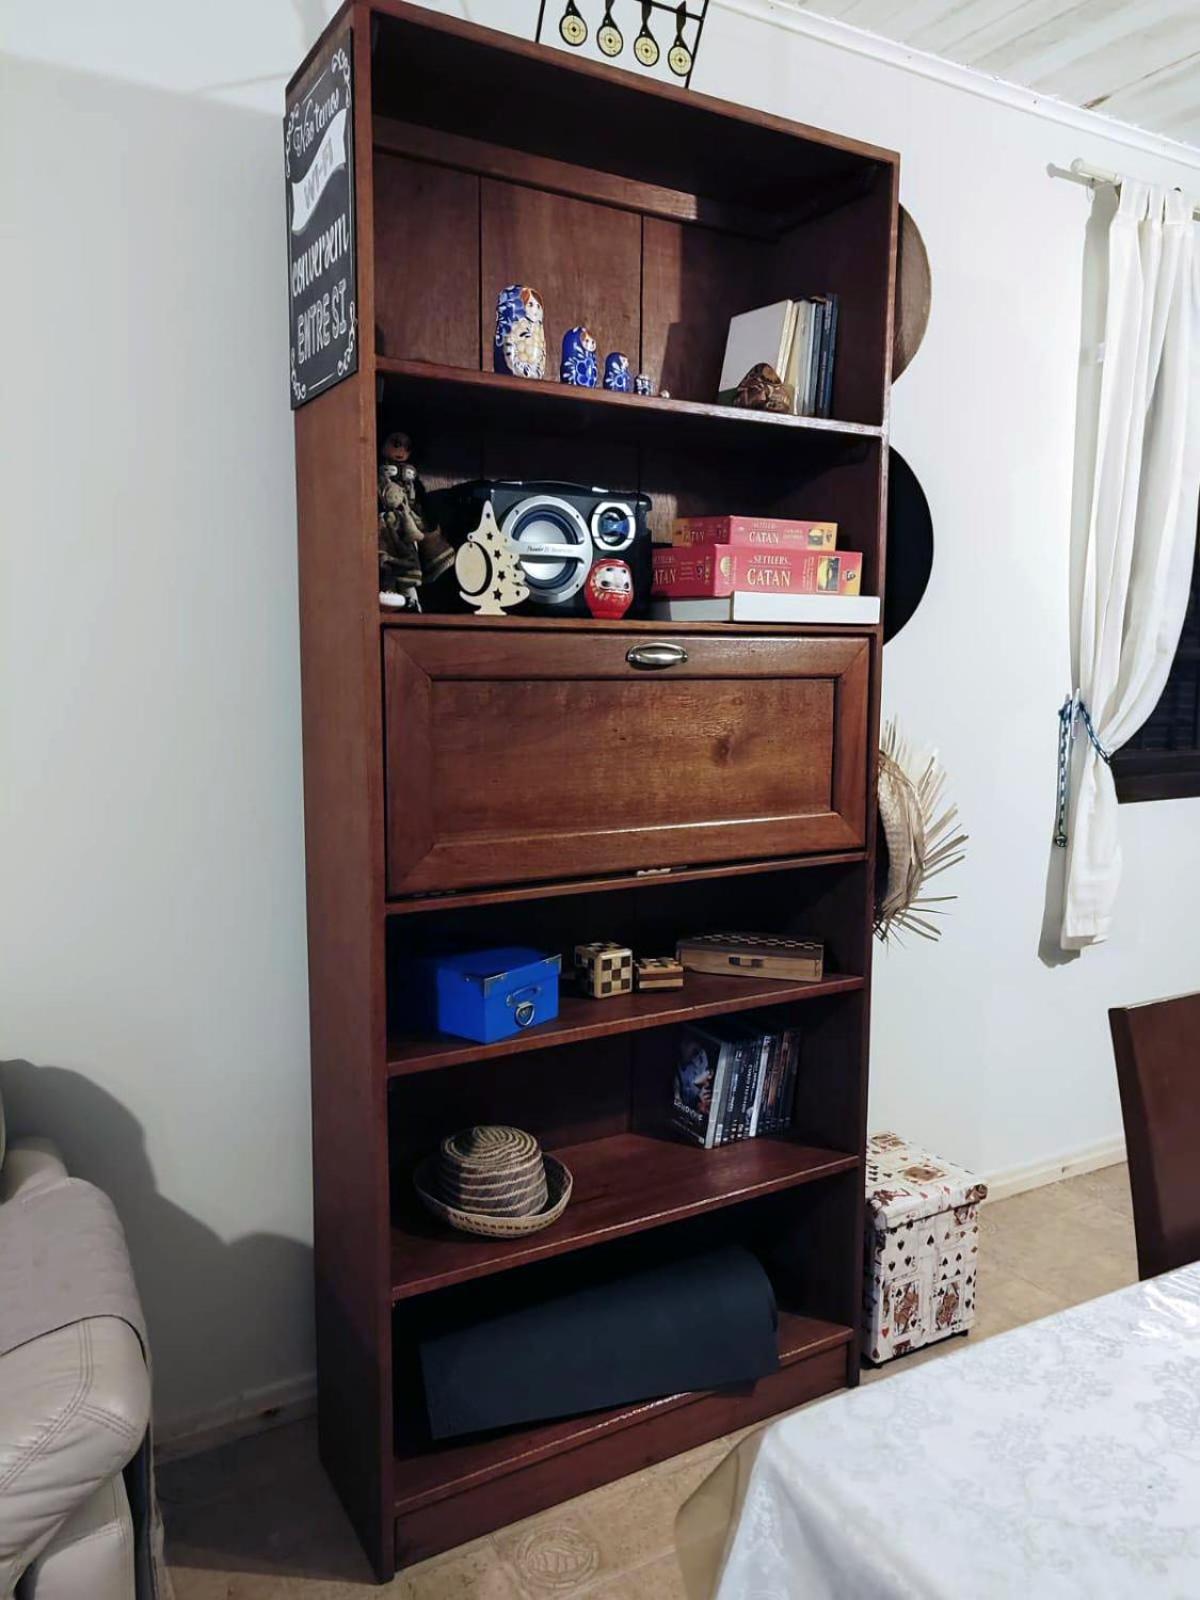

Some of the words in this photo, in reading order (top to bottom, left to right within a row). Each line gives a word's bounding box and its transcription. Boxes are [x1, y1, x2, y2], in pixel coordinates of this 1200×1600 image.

[298, 293, 331, 364] ENTRE
[332, 278, 347, 339] SI
[749, 531, 779, 545] CATAN
[752, 554, 789, 566] SETTLERS
[747, 568, 791, 587] CATAN
